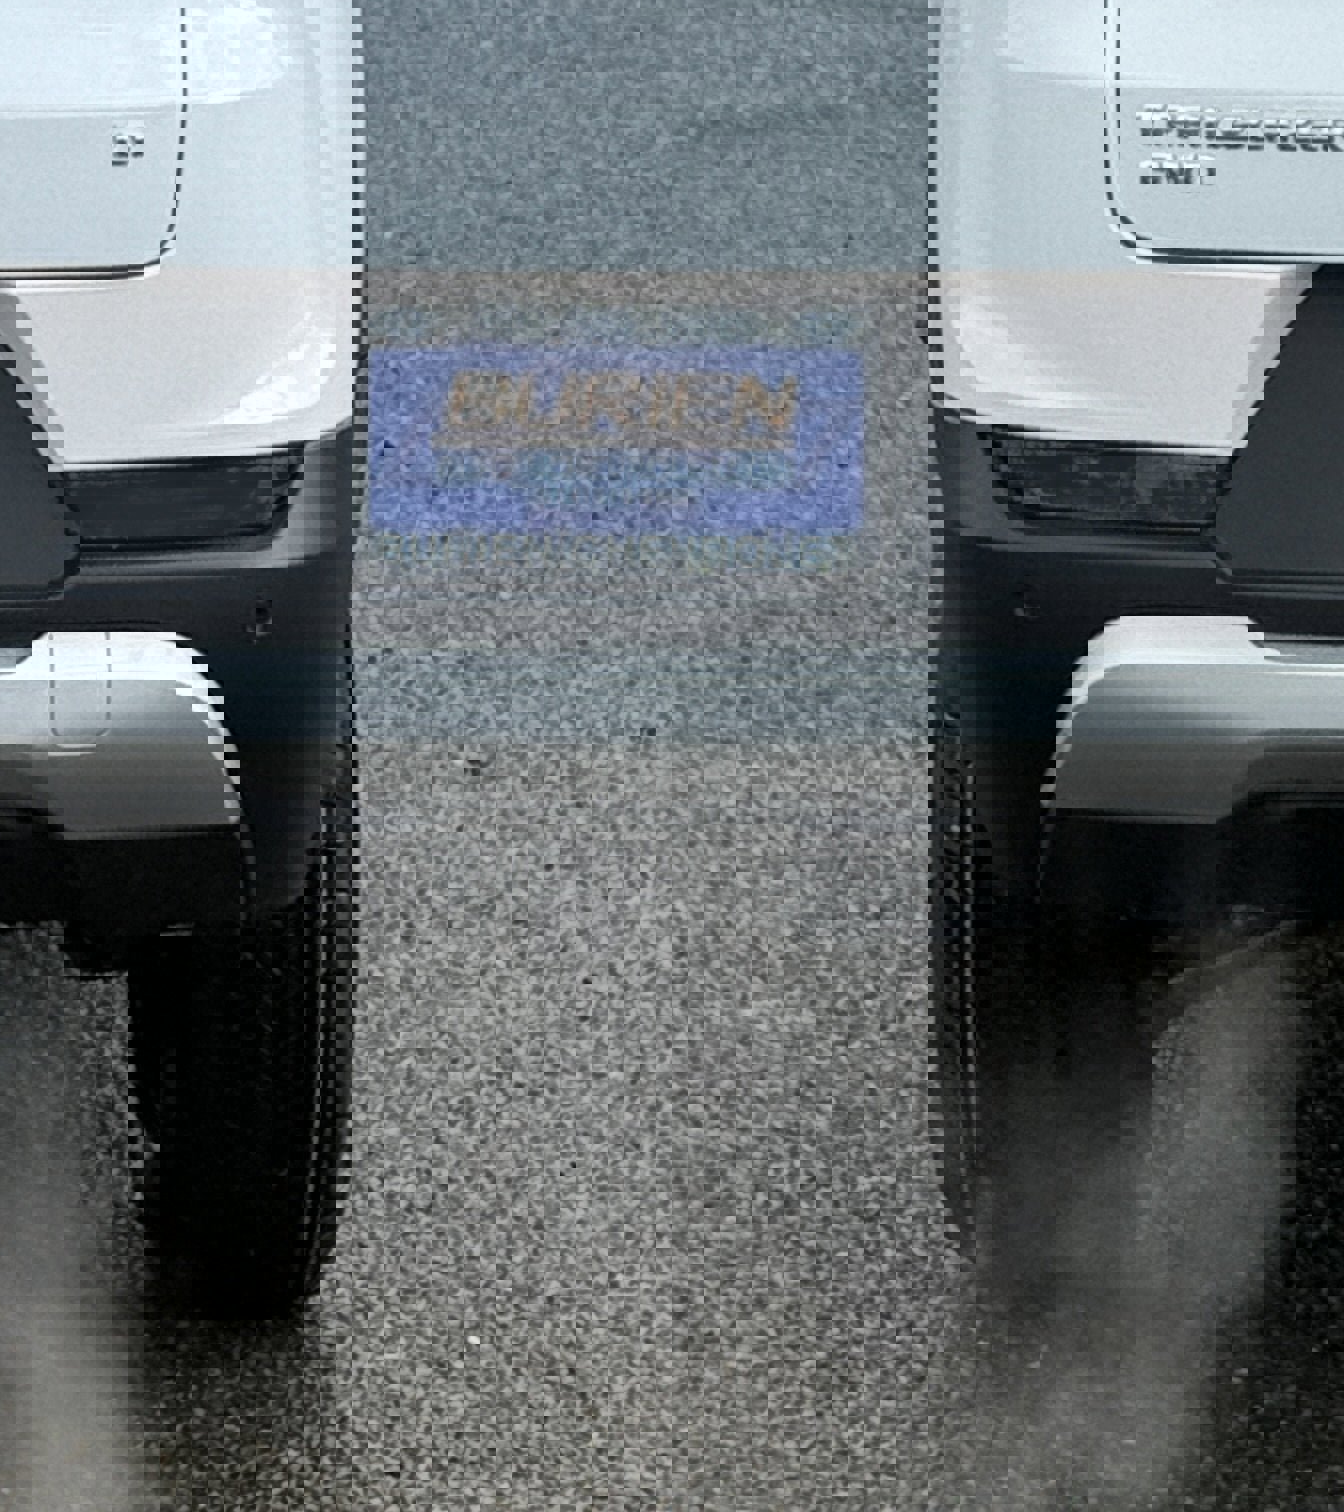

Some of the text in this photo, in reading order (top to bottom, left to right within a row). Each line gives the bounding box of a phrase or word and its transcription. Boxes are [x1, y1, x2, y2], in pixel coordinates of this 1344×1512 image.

[473, 307, 764, 345] 206-243-5800
[443, 370, 803, 435] BURIEN
[375, 532, 856, 573] BURIEN CHEVROLET
